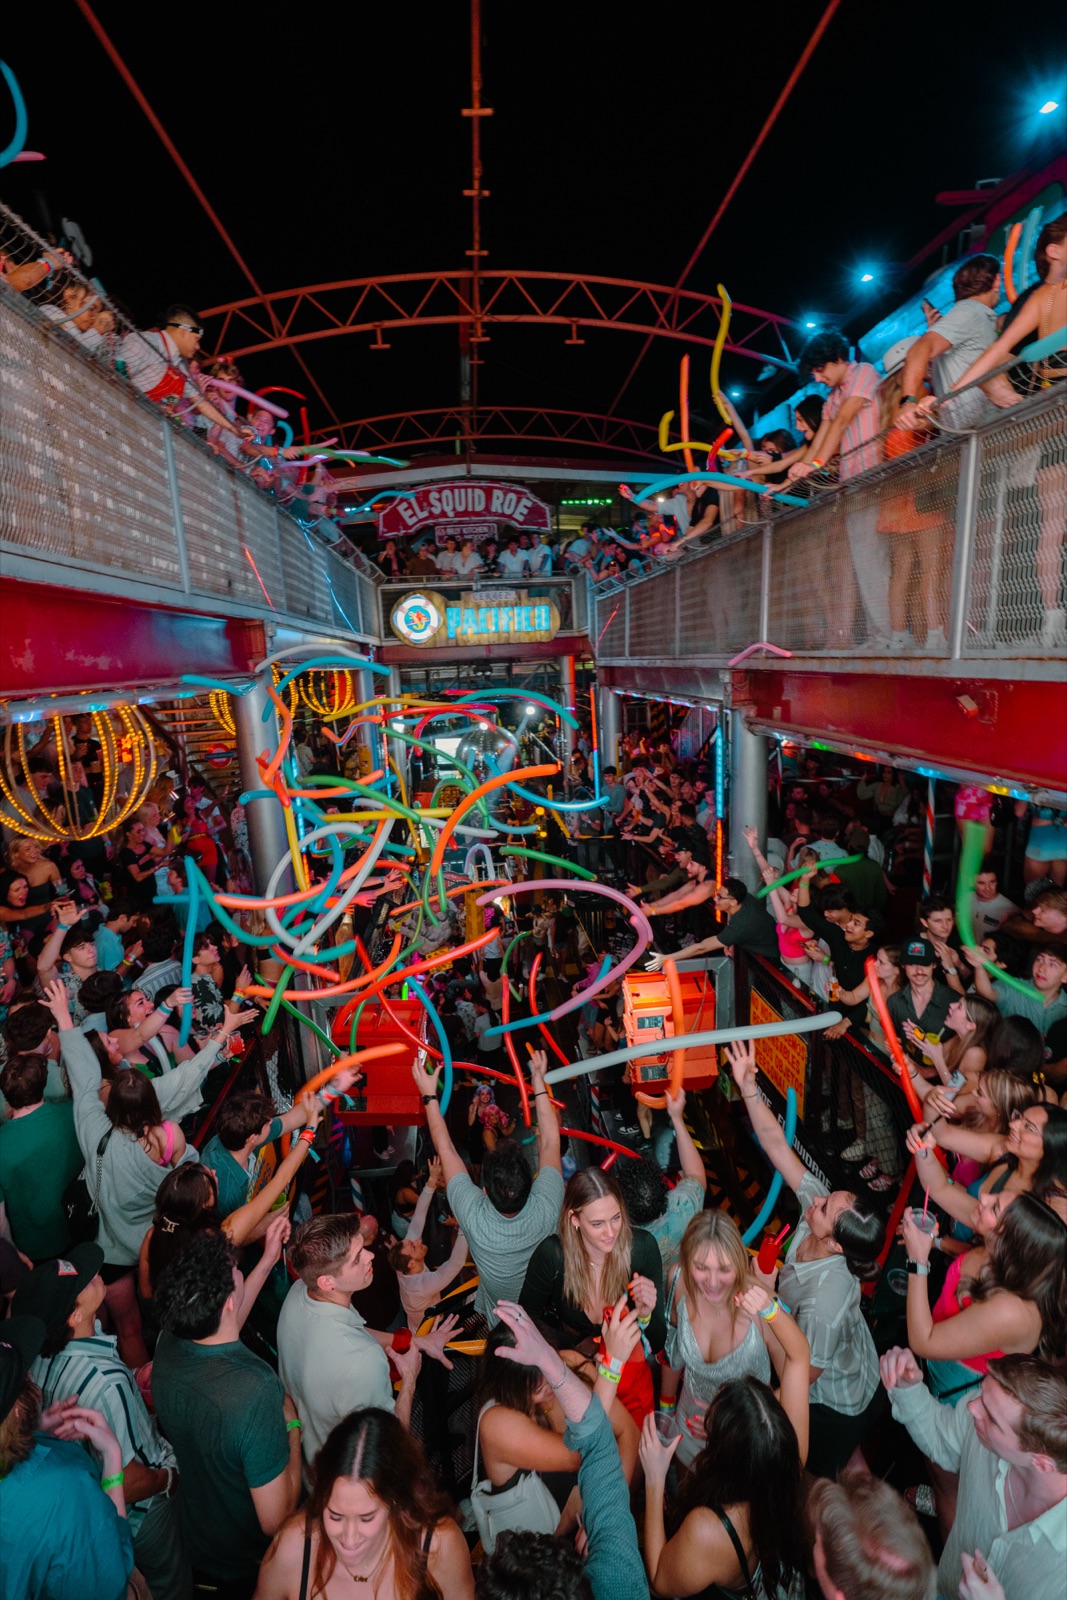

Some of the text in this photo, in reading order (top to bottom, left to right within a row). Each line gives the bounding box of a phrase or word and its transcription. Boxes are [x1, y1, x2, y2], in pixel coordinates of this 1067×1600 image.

[396, 488, 533, 526] EL SQUID ROE
[446, 605, 550, 639] PACIFICO
[751, 992, 758, 1011] NO
[761, 1037, 773, 1062] SUS
[774, 1053, 803, 1098] OBJETOS
